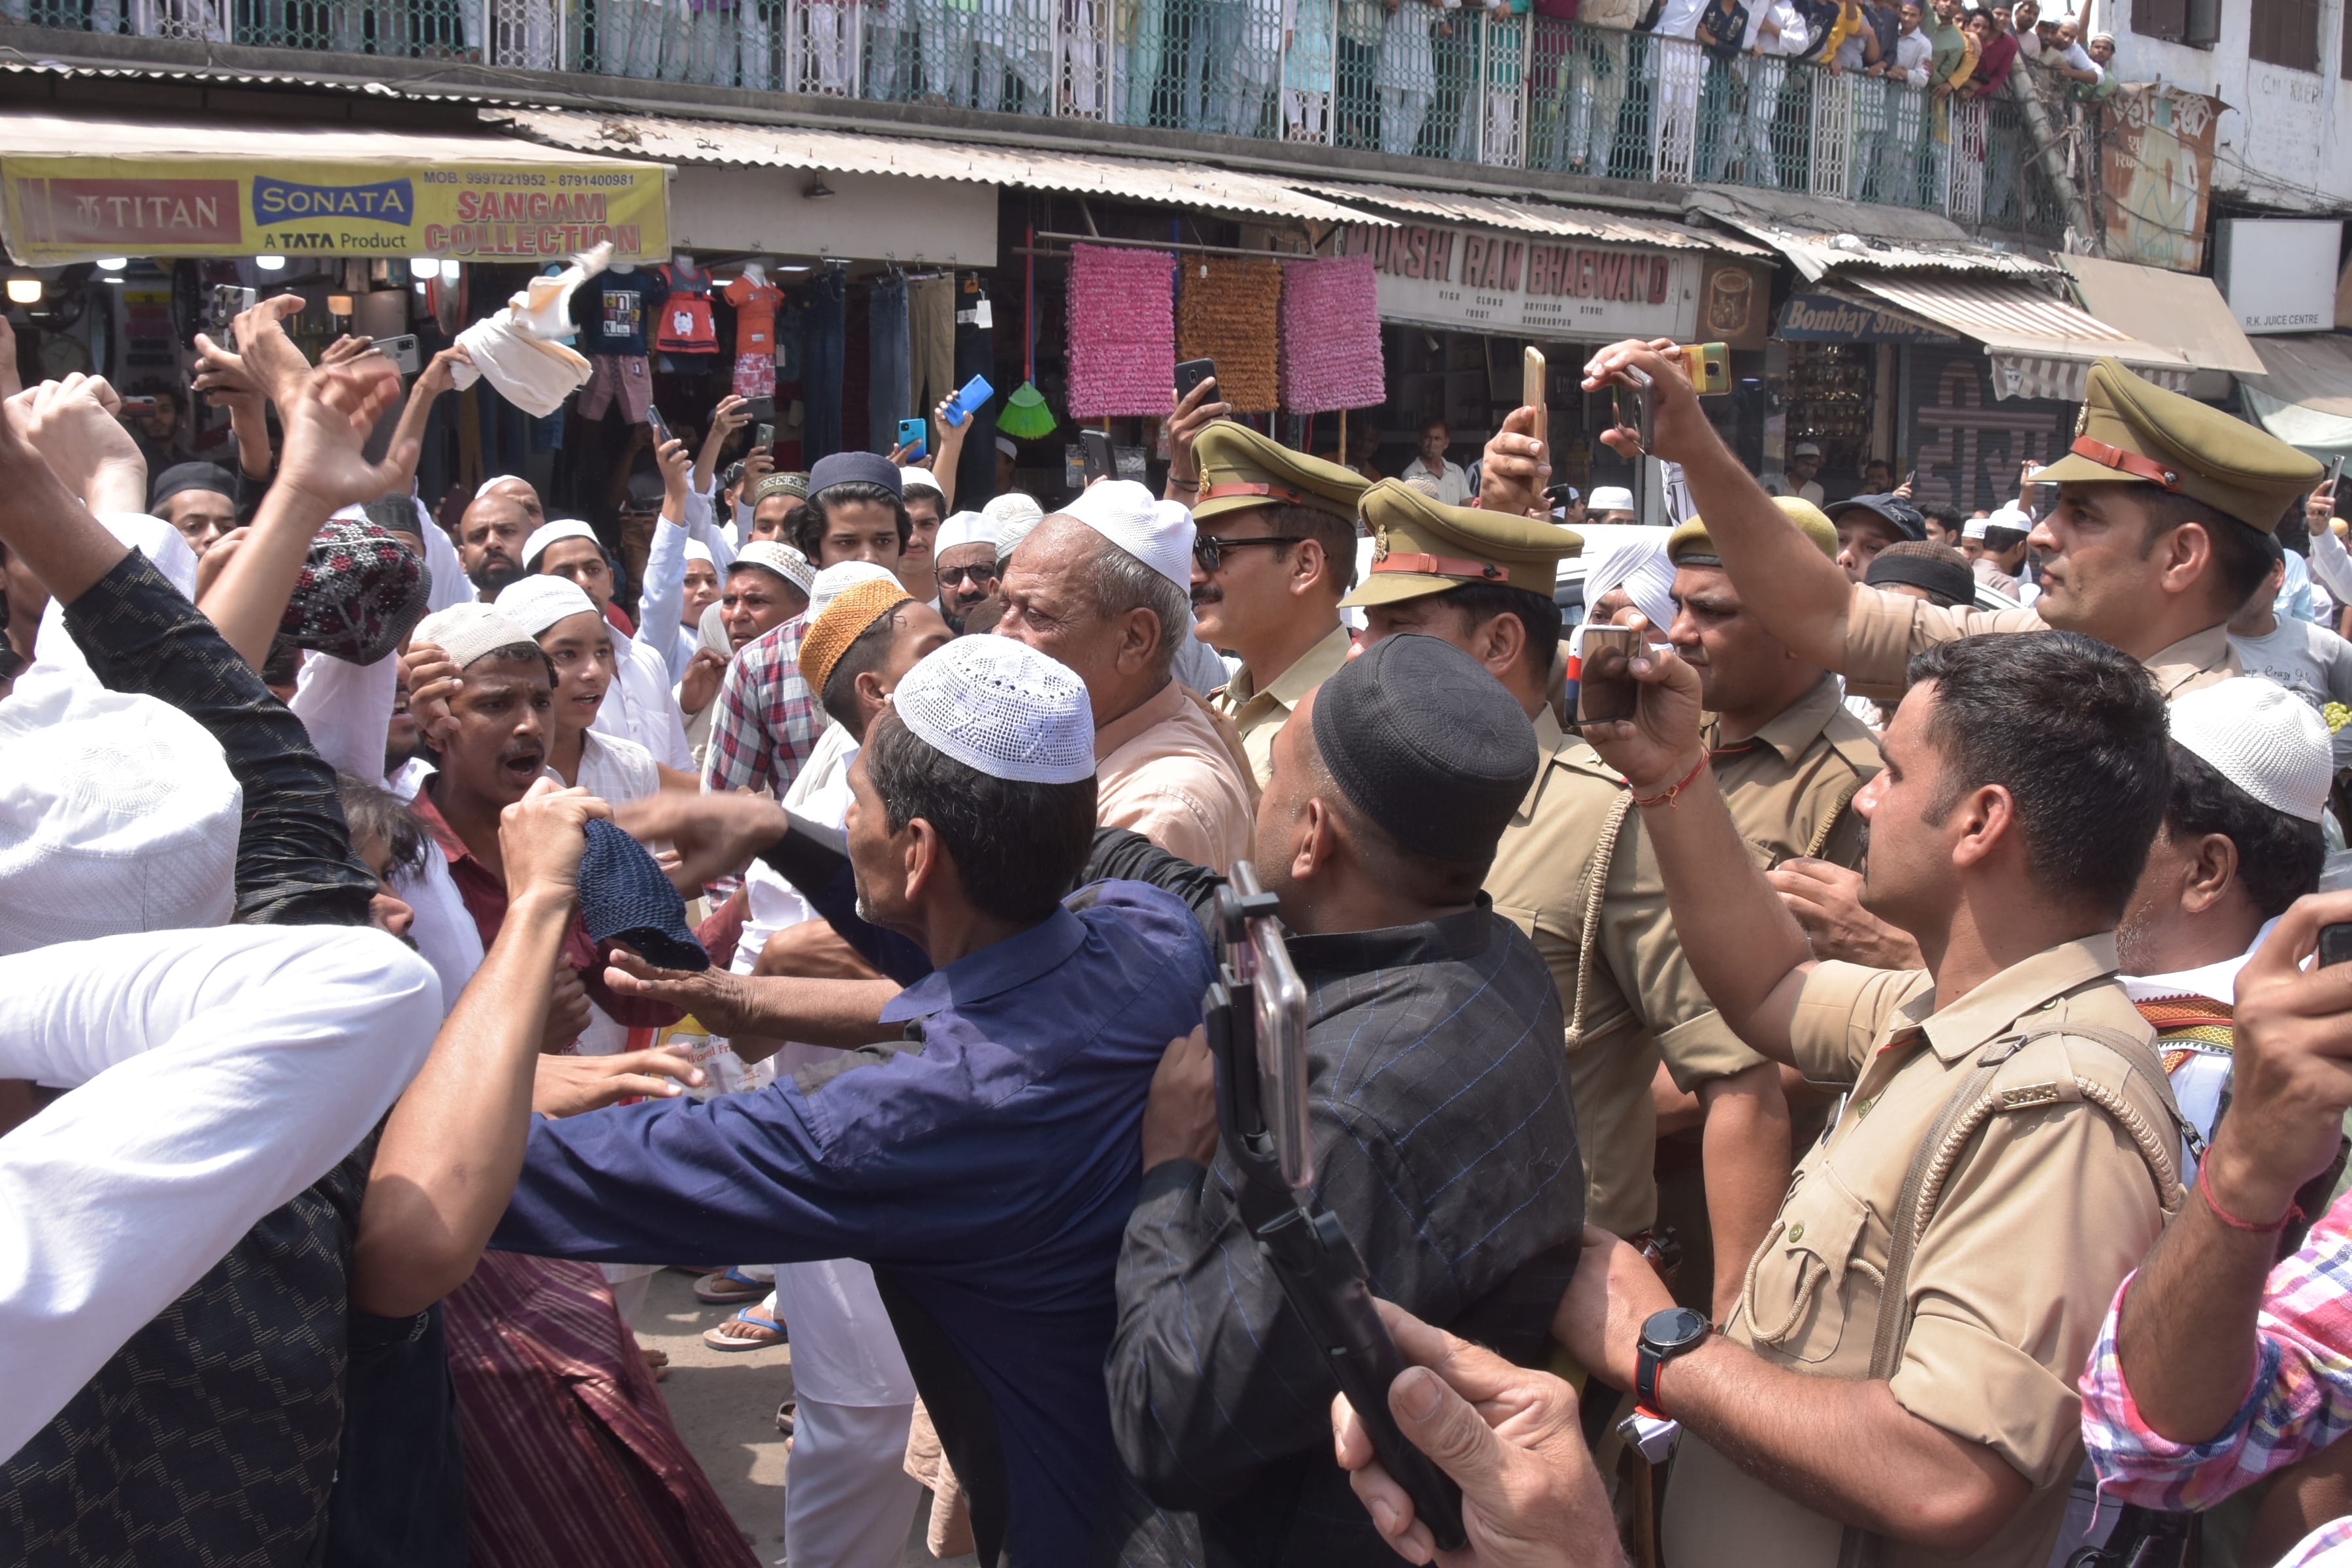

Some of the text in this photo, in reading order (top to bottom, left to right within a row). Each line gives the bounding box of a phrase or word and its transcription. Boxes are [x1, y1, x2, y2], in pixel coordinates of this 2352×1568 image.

[424, 172, 461, 184] MOB.
[466, 173, 546, 186] 9997221952
[559, 174, 634, 186] 8791400981
[106, 196, 218, 229] TITAN
[262, 188, 405, 213] SONATA
[457, 190, 606, 223] SANGAM
[265, 233, 406, 248] A TATA Product
[423, 223, 641, 256] COLLECTION
[1460, 235, 1524, 291] RAM
[1786, 301, 1872, 340] Bombay
[2264, 315, 2287, 325] JUICE
[2289, 314, 2319, 325] CENTRE
[2264, 665, 2291, 681] Crazy
